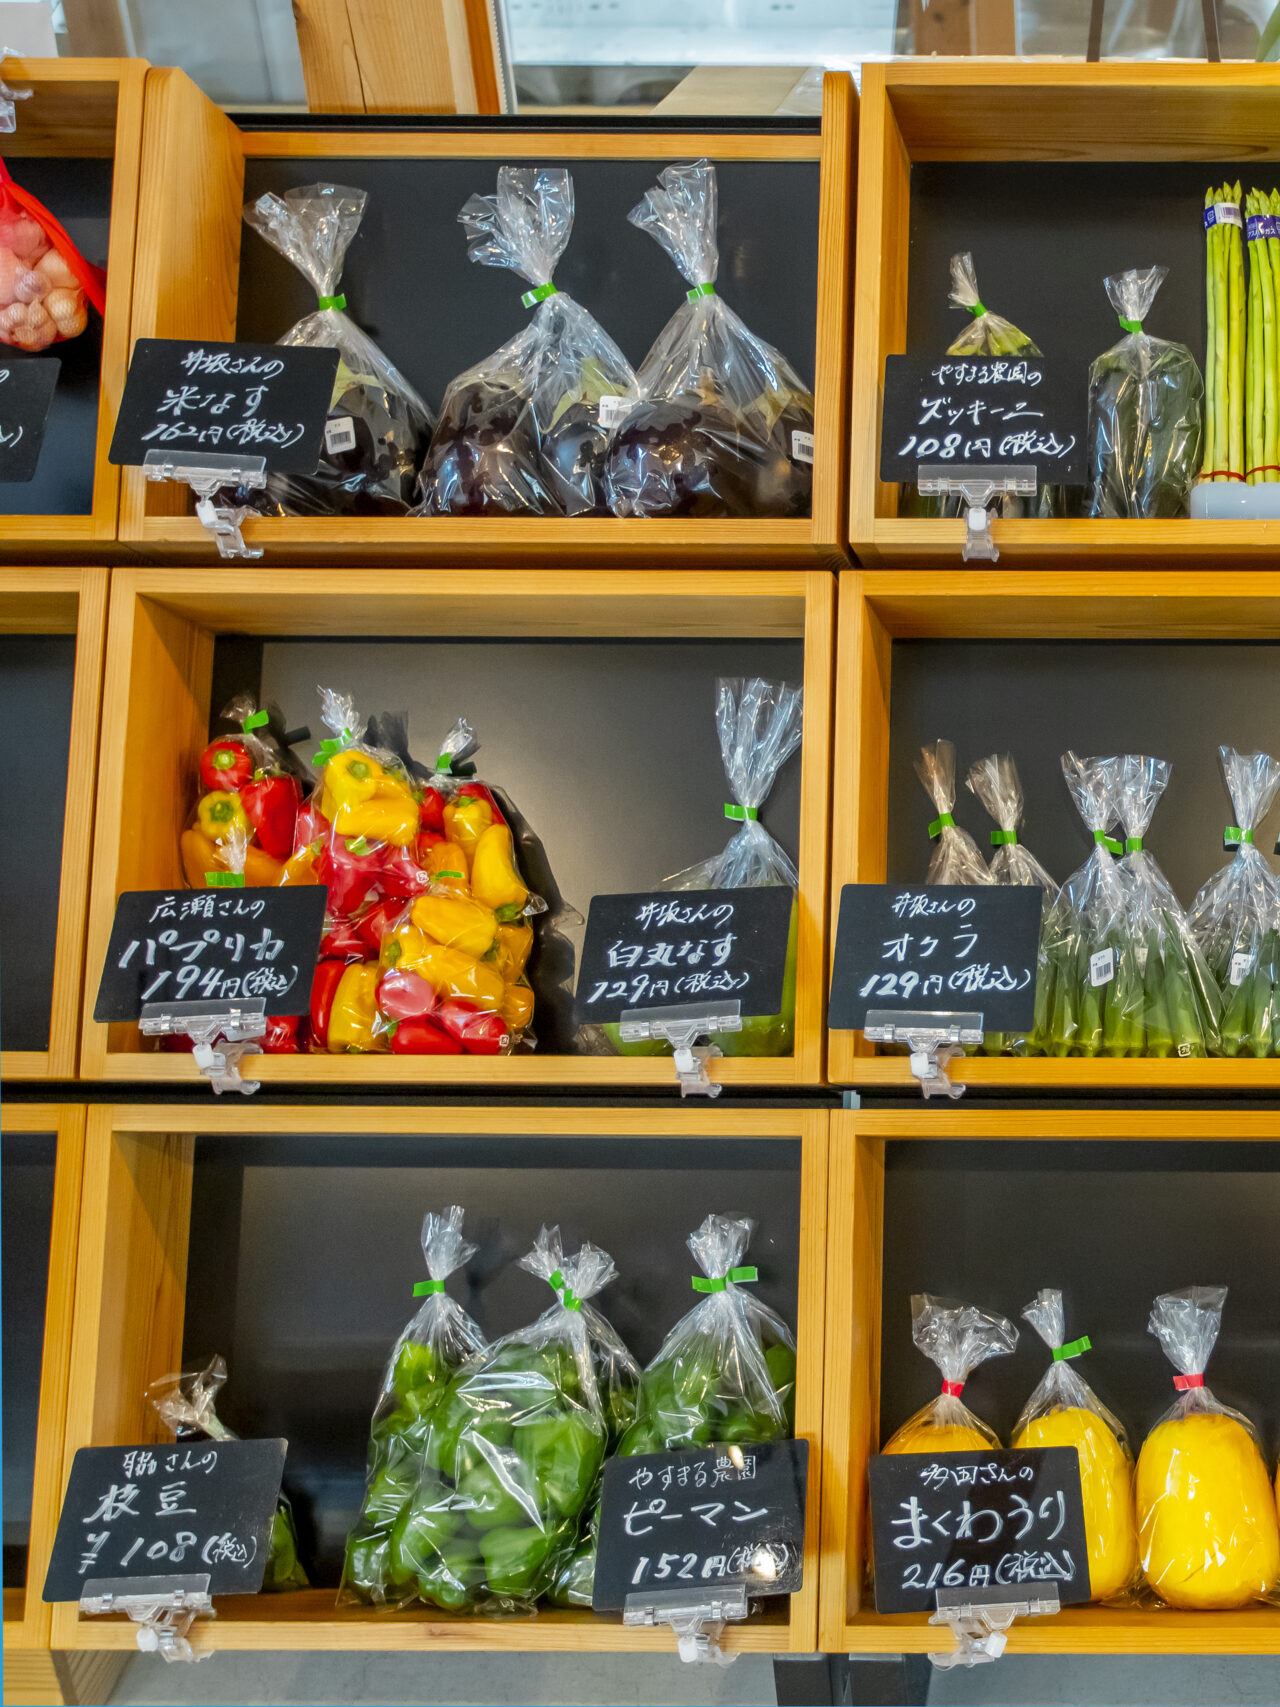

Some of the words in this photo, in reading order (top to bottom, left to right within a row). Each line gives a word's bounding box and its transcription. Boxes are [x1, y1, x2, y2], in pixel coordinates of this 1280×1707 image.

[932, 362, 1042, 387] やすまる農園の
[156, 385, 269, 416] 米なす
[918, 397, 1044, 426] ズッキーニ
[898, 430, 1076, 459] 108円(税込)
[118, 927, 285, 968] パプリカ
[607, 933, 738, 967] 白丸なす
[882, 924, 978, 962] オクラ
[141, 965, 298, 1000] 194円(税込)
[859, 963, 1031, 999] 129円(税込)
[629, 1455, 756, 1491] やすまる農園
[82, 1481, 197, 1523] 枝豆
[624, 1498, 769, 1536] ピーマン
[891, 1490, 1066, 1549] まくわうり
[901, 1549, 1076, 1590] 216円(税込)
